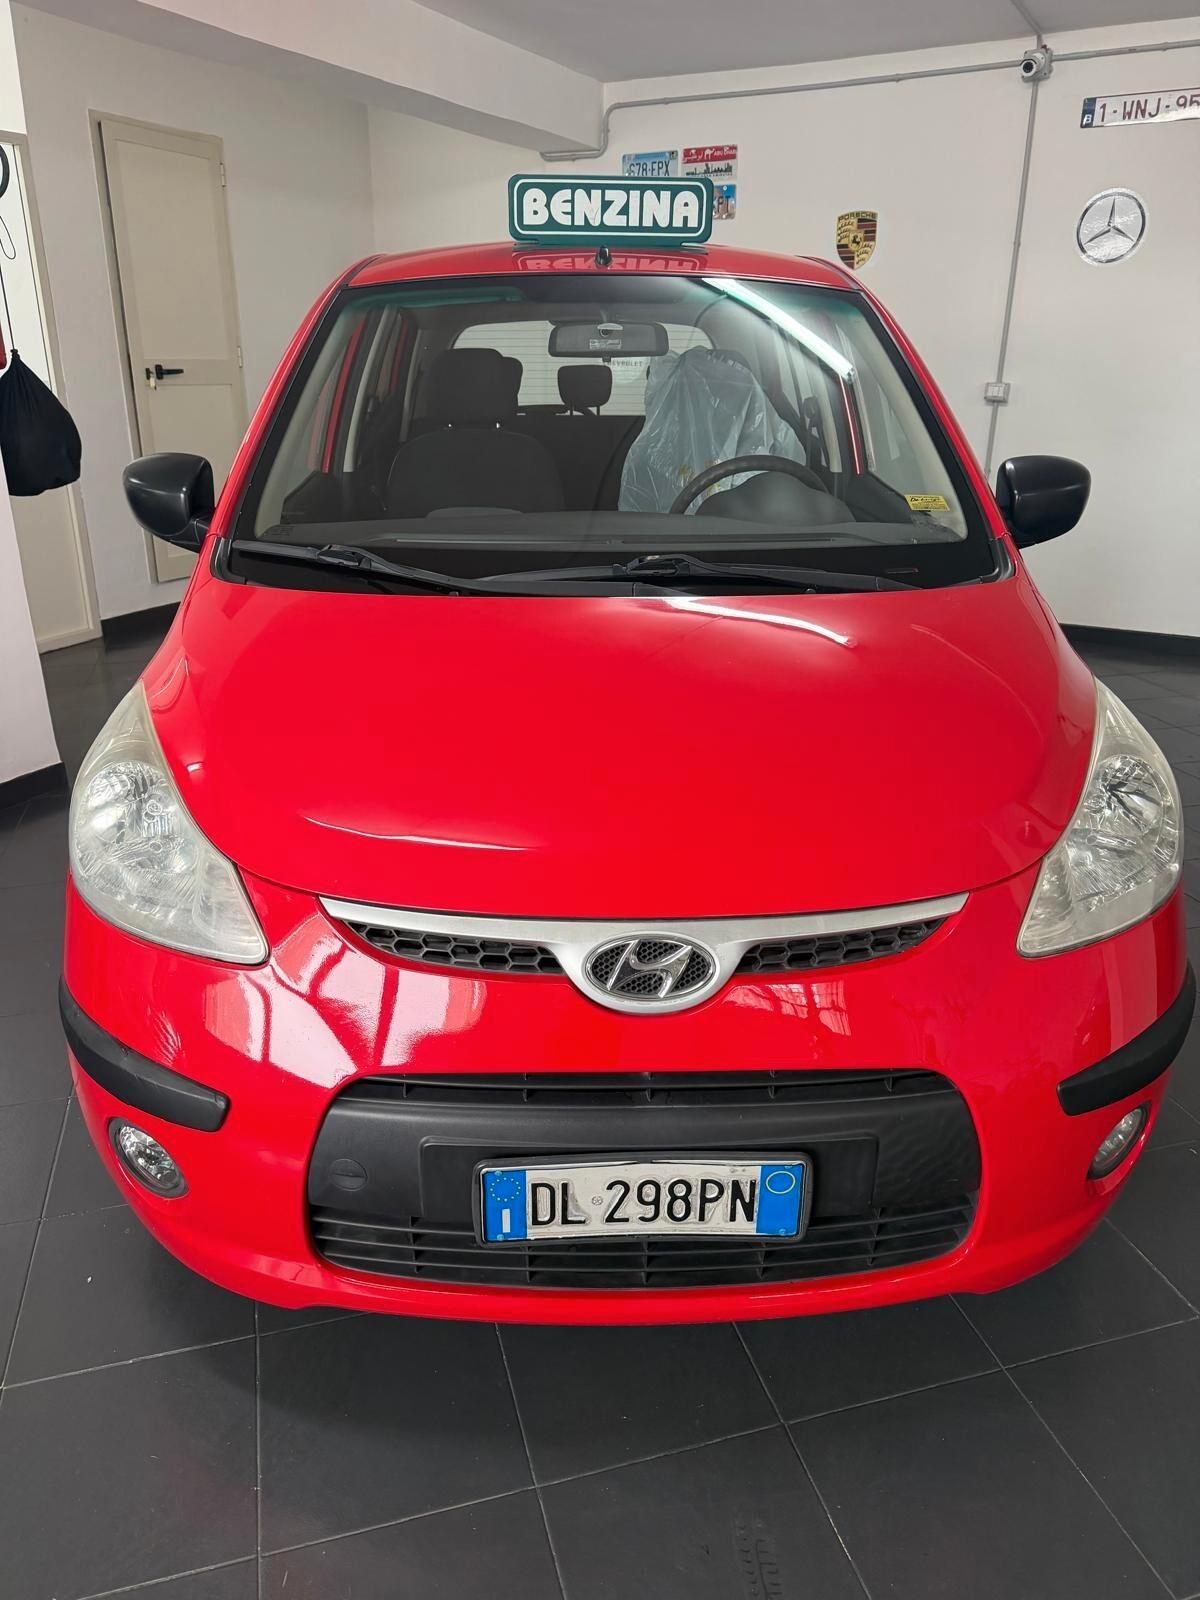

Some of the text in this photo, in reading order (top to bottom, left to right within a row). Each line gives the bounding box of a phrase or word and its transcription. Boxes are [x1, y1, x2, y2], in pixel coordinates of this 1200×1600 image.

[522, 187, 699, 228] BENZINA
[530, 1178, 757, 1226] DL 298PN
